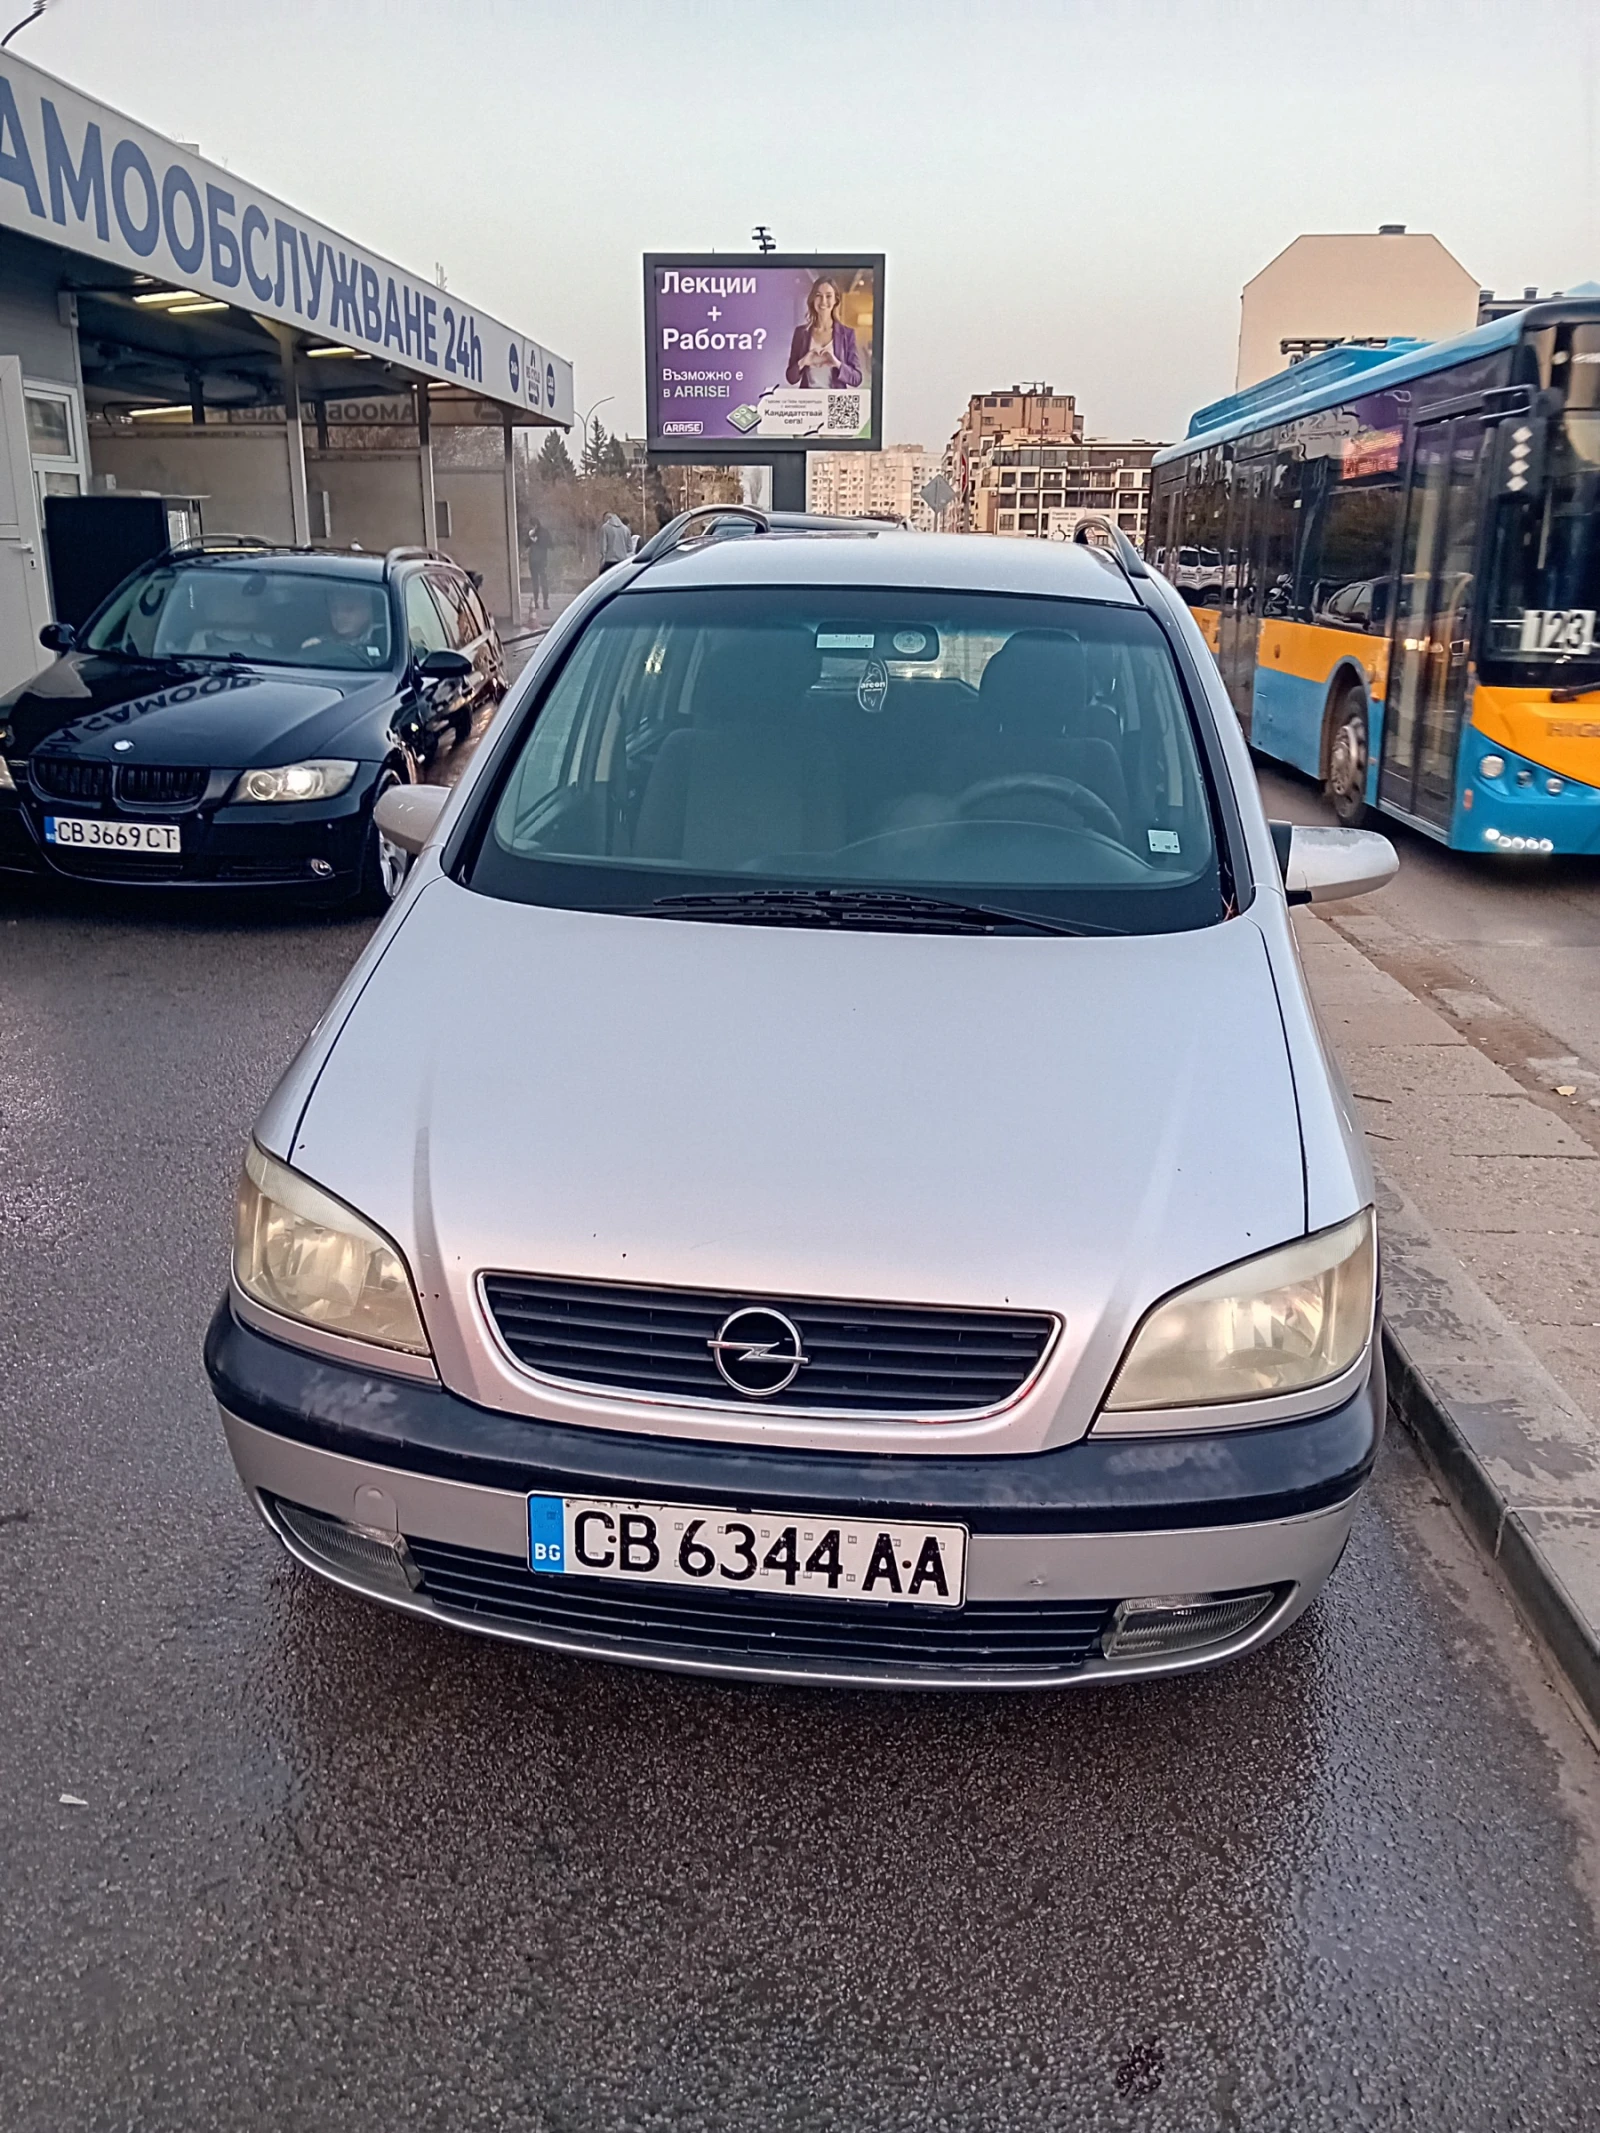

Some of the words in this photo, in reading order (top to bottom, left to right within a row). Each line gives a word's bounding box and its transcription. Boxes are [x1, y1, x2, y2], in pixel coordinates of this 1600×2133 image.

[661, 271, 757, 298] Лекции
[444, 307, 483, 383] 24h
[663, 328, 767, 350] Работа?
[663, 368, 732, 381] Възможно
[735, 371, 743, 381] е
[663, 388, 670, 398] в
[674, 385, 730, 398] ARRISE!
[764, 409, 823, 417] Кандидатствай
[665, 423, 701, 433] ARRISE
[1535, 611, 1585, 650] 123
[58, 821, 84, 843] CB
[89, 824, 141, 847] 3669
[146, 827, 175, 849] CT
[535, 1543, 560, 1561] BG
[574, 1510, 660, 1572] CB
[678, 1519, 843, 1589] 6344
[861, 1533, 949, 1597] AA
